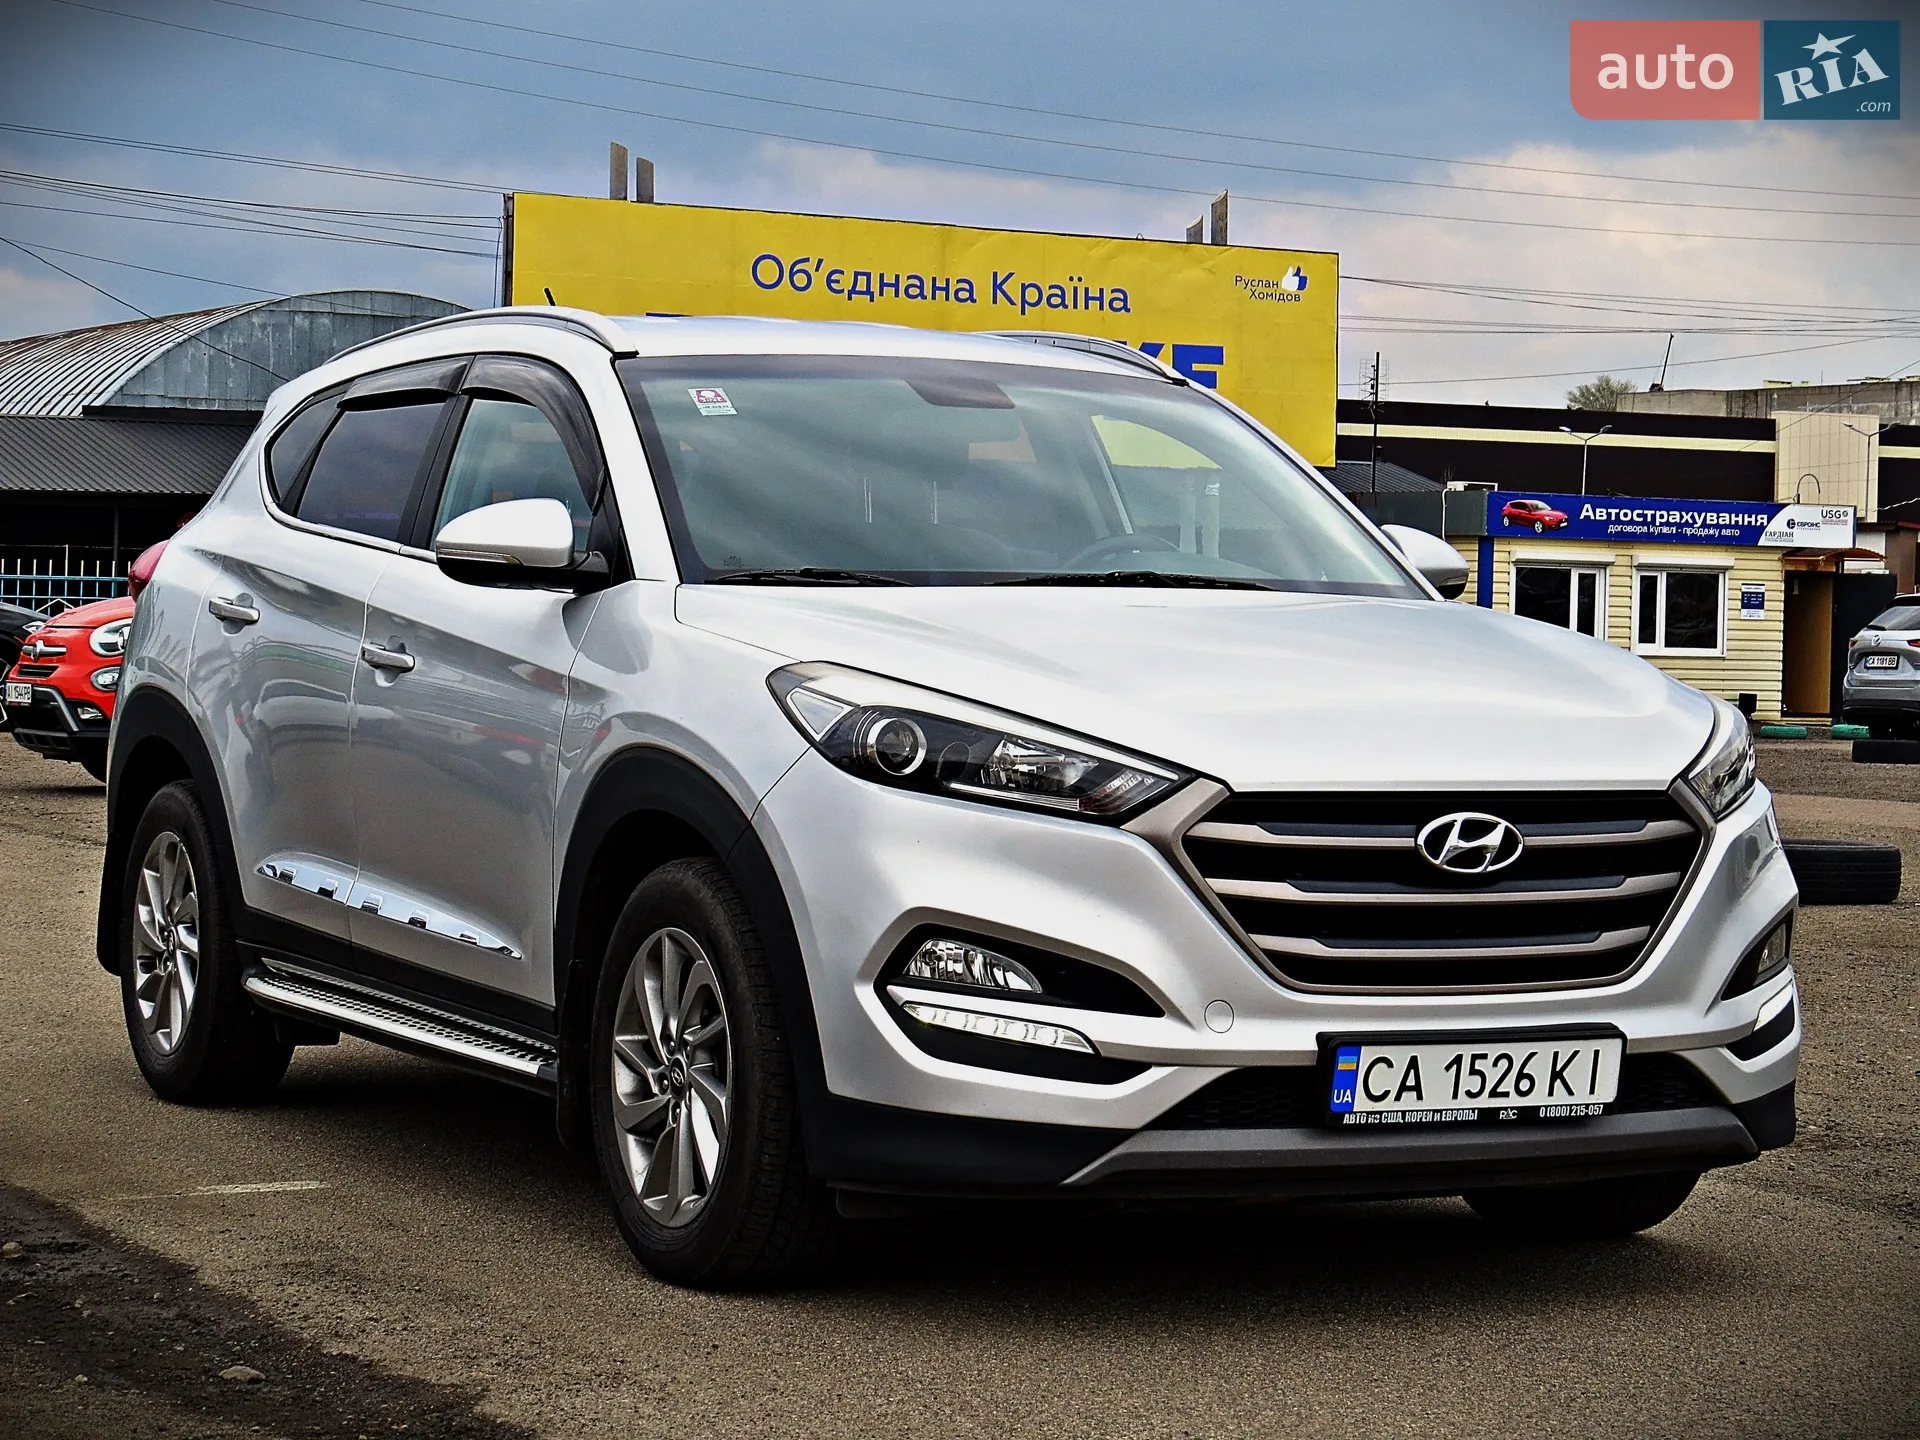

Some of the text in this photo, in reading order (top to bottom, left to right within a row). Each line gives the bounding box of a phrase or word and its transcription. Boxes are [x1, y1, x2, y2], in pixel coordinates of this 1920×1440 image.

[751, 253, 1132, 316] Об'єднана Країна
[1234, 275, 1280, 290] Руслан
[1248, 288, 1302, 303] Хомідов
[1579, 503, 1769, 528] Автострахування
[1820, 509, 1842, 519] USG
[1607, 524, 1648, 534] договора
[1649, 525, 1677, 536] купівлі
[1682, 527, 1720, 538] продажу
[1720, 529, 1741, 537] авто
[1764, 530, 1794, 539] ГАРДІАН
[1362, 1048, 1601, 1103] CA 1526 KI
[1332, 1088, 1353, 1104] UA
[1343, 1112, 1368, 1125] АВТО
[1381, 1111, 1404, 1124] США,
[1405, 1110, 1434, 1123] КОРЕИ
[1433, 1111, 1441, 1122] и
[1441, 1109, 1479, 1121] ЕВРОПЫ
[1539, 1104, 1604, 1118] 0 (800) 215-057
